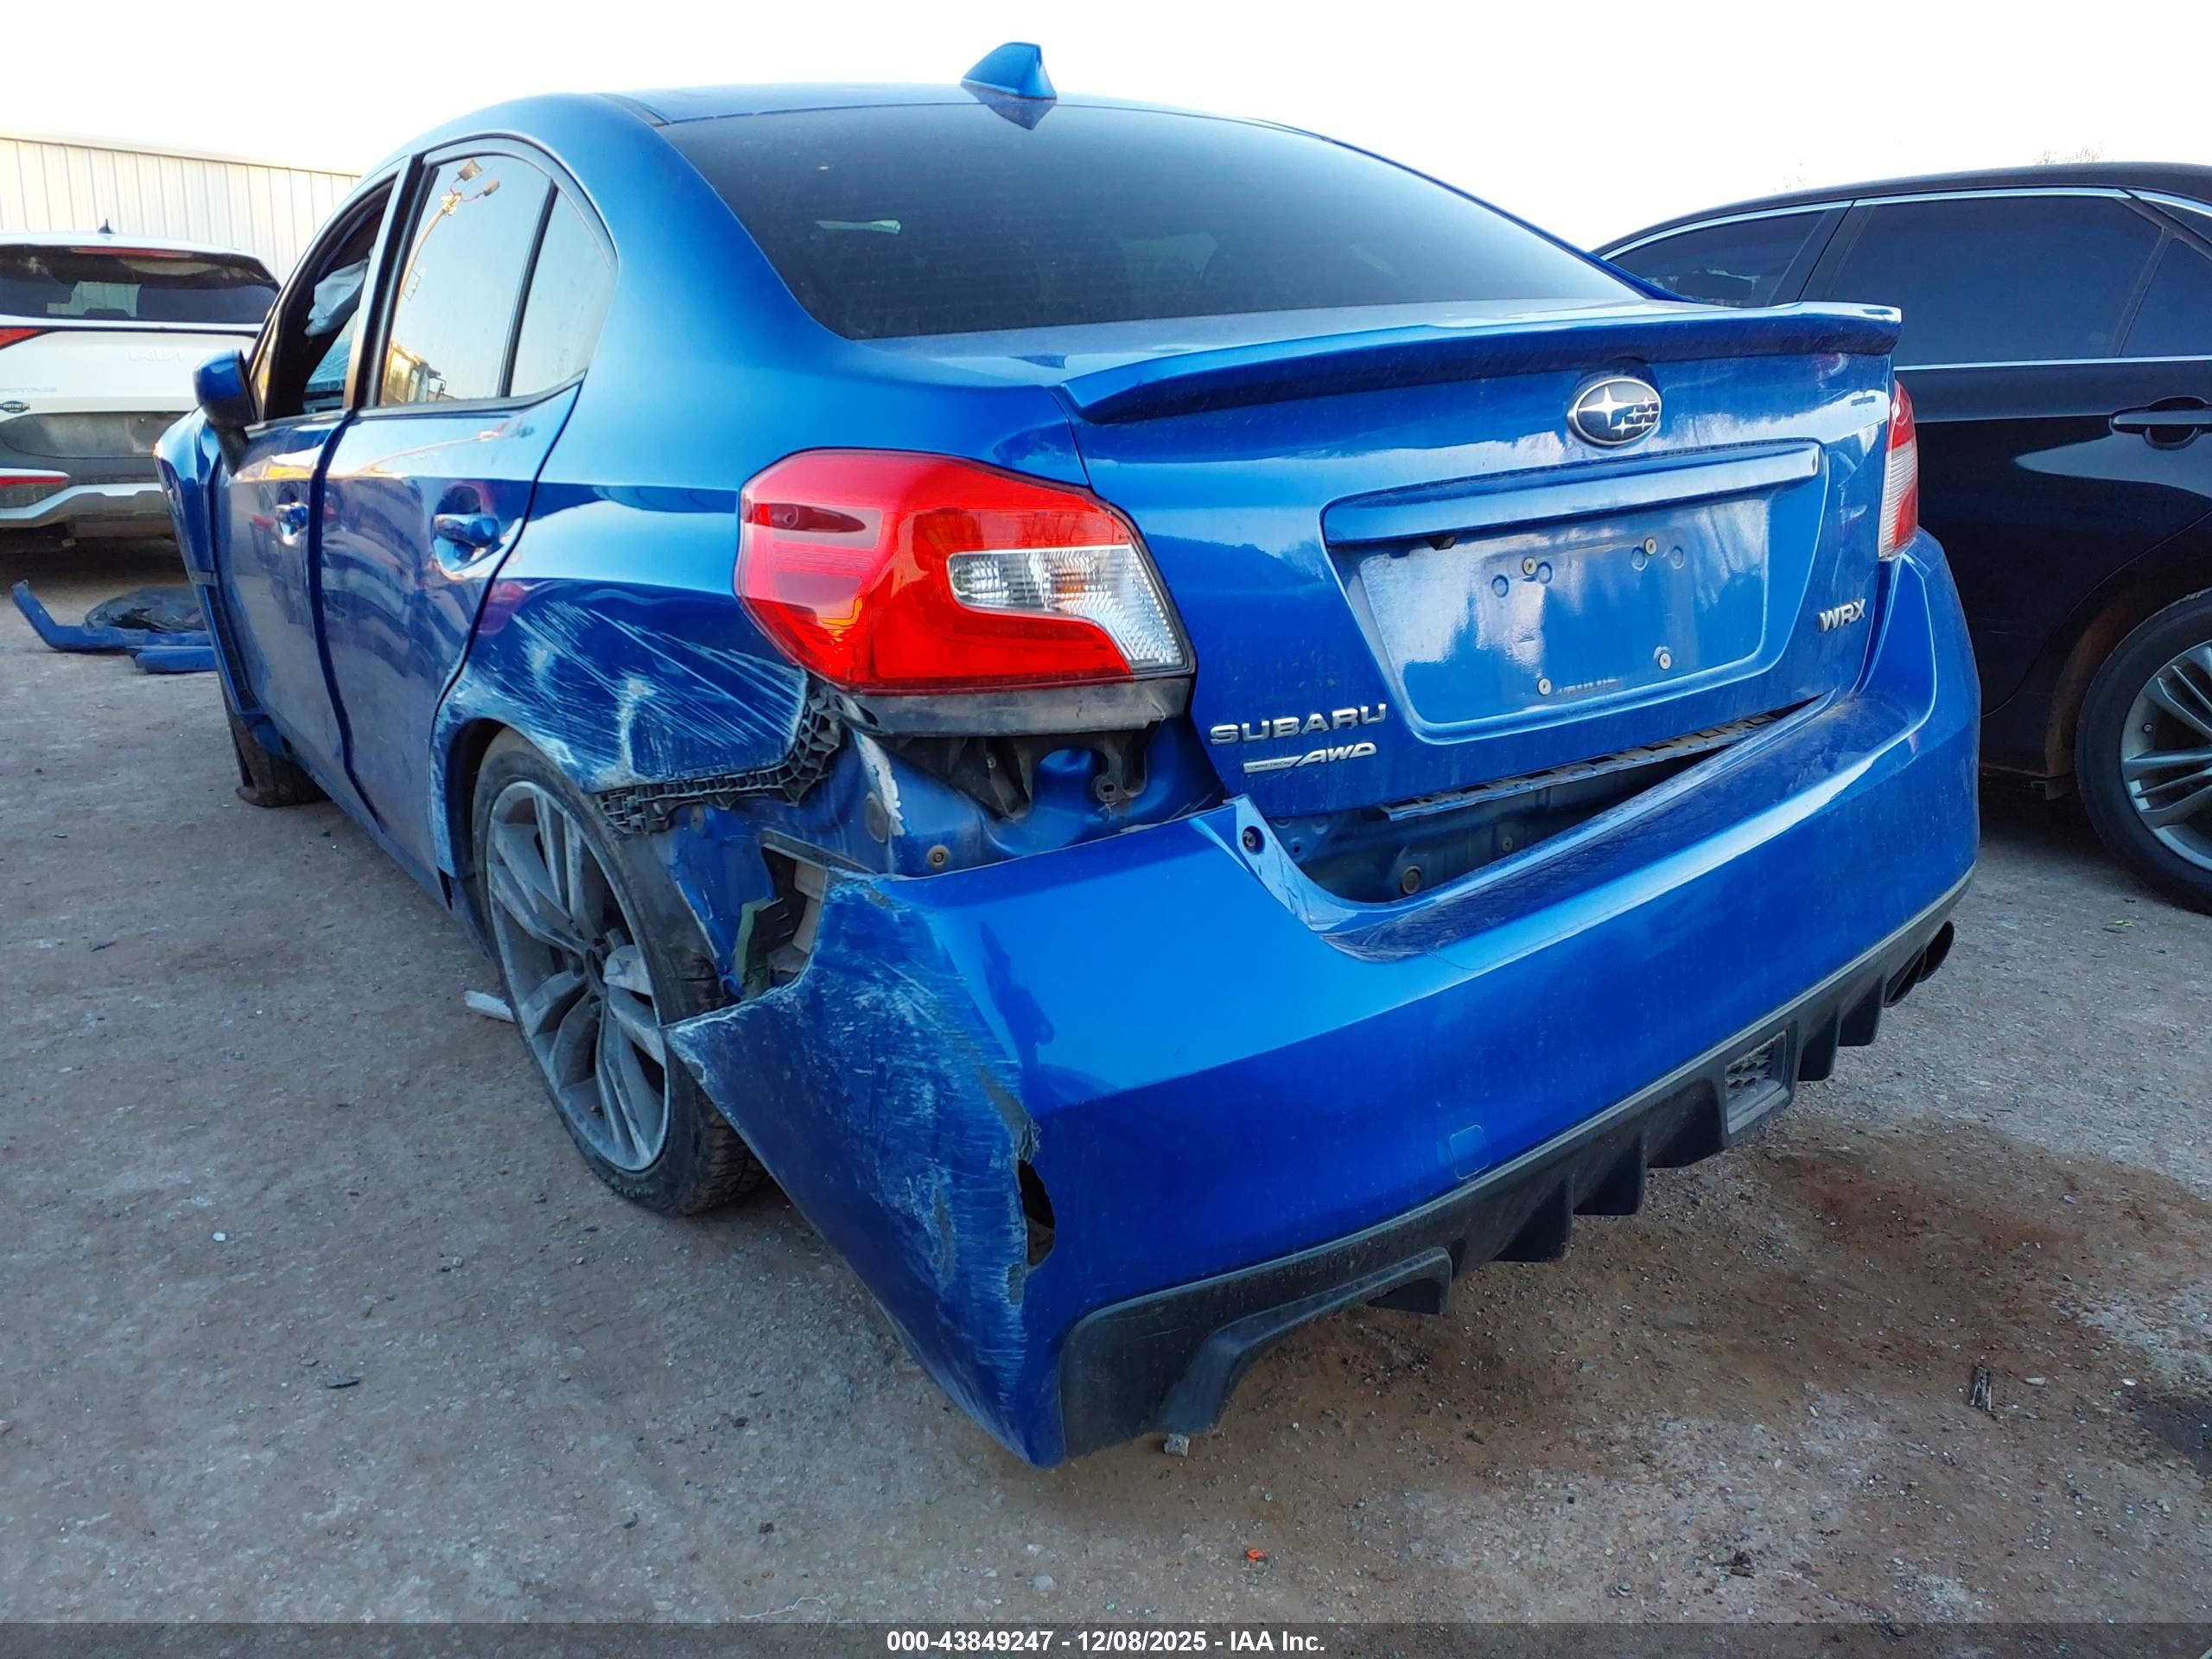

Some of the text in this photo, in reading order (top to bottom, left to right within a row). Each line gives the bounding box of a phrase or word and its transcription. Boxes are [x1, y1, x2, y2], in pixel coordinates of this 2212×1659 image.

[1818, 598, 1866, 632] WRX
[1210, 703, 1387, 745] SUBARU
[1295, 742, 1377, 767] AWD
